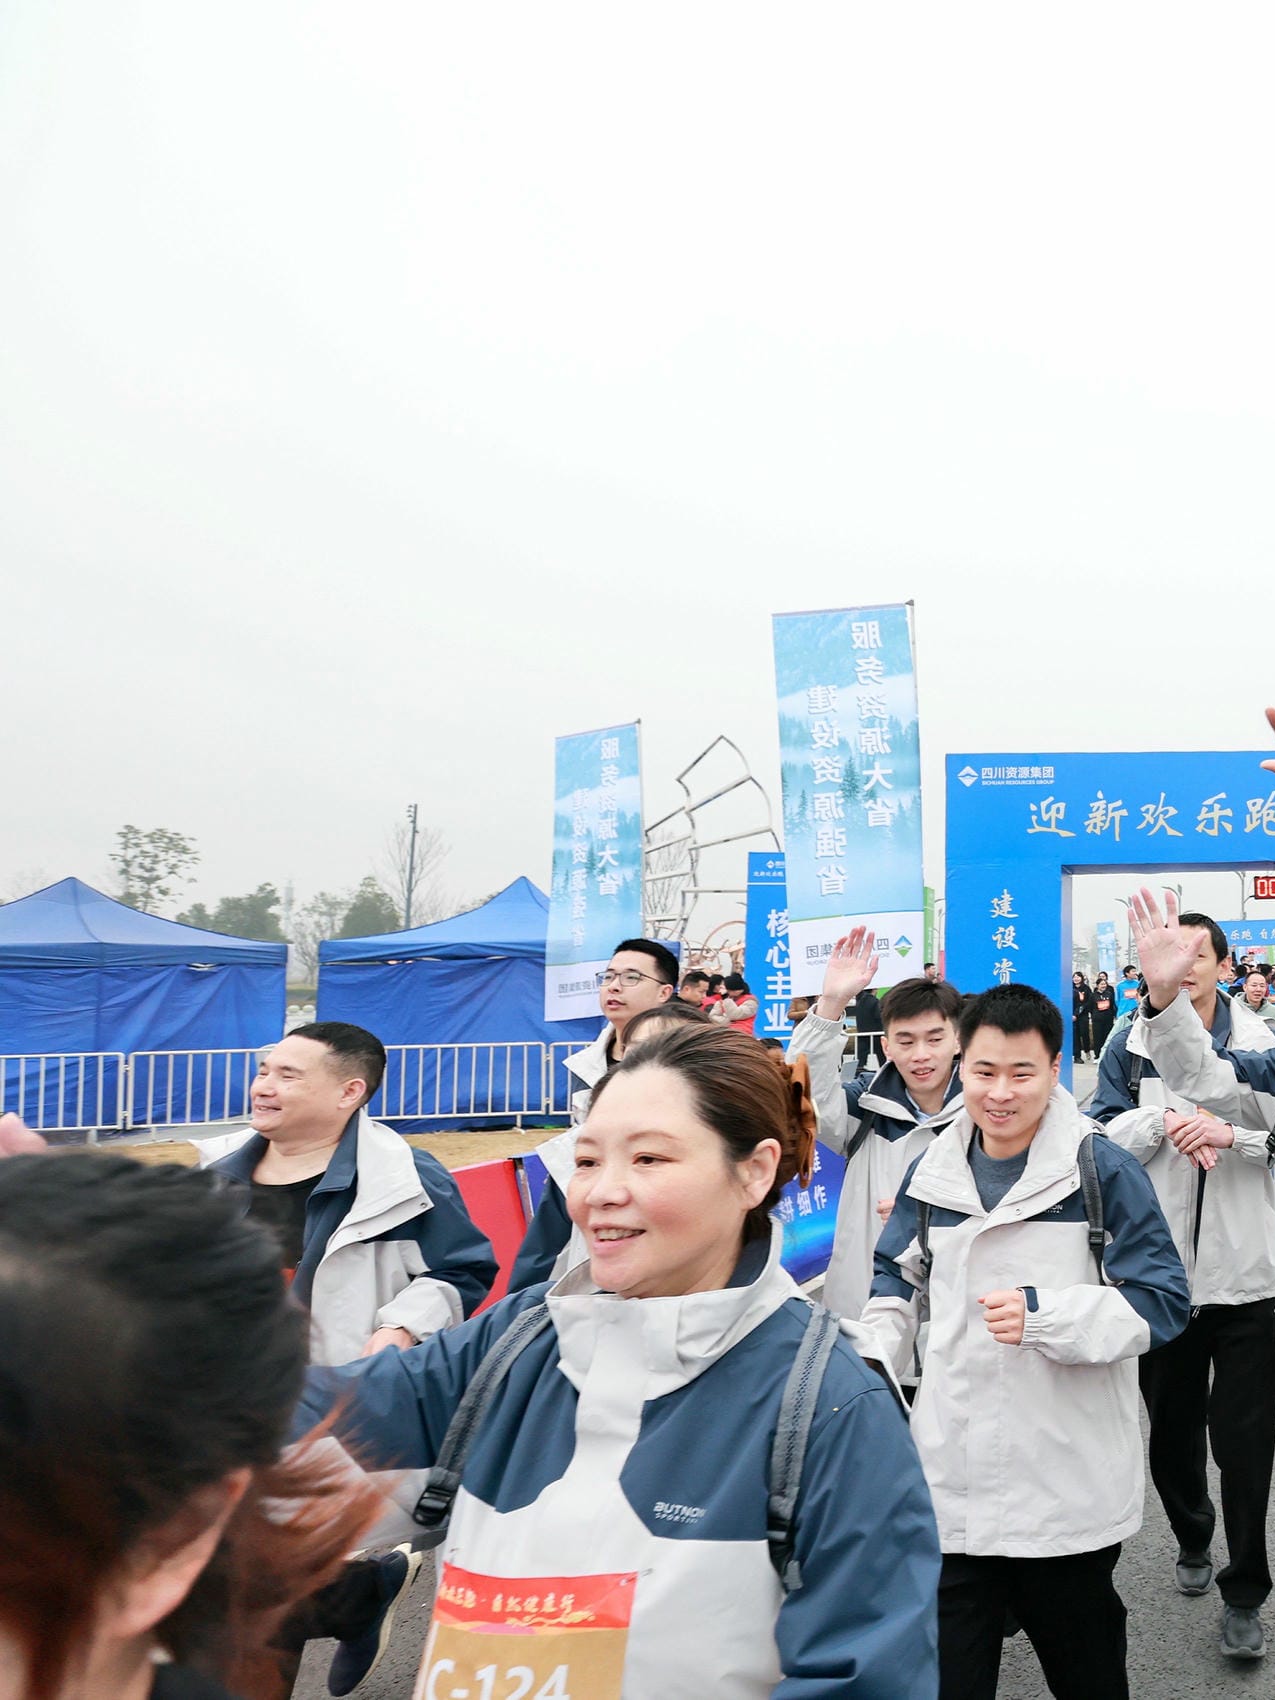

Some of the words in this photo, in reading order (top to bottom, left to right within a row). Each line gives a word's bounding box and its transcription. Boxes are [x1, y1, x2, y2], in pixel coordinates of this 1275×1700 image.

[981, 766, 1055, 779] 四川资源集团
[425, 1657, 571, 1700] C-124
